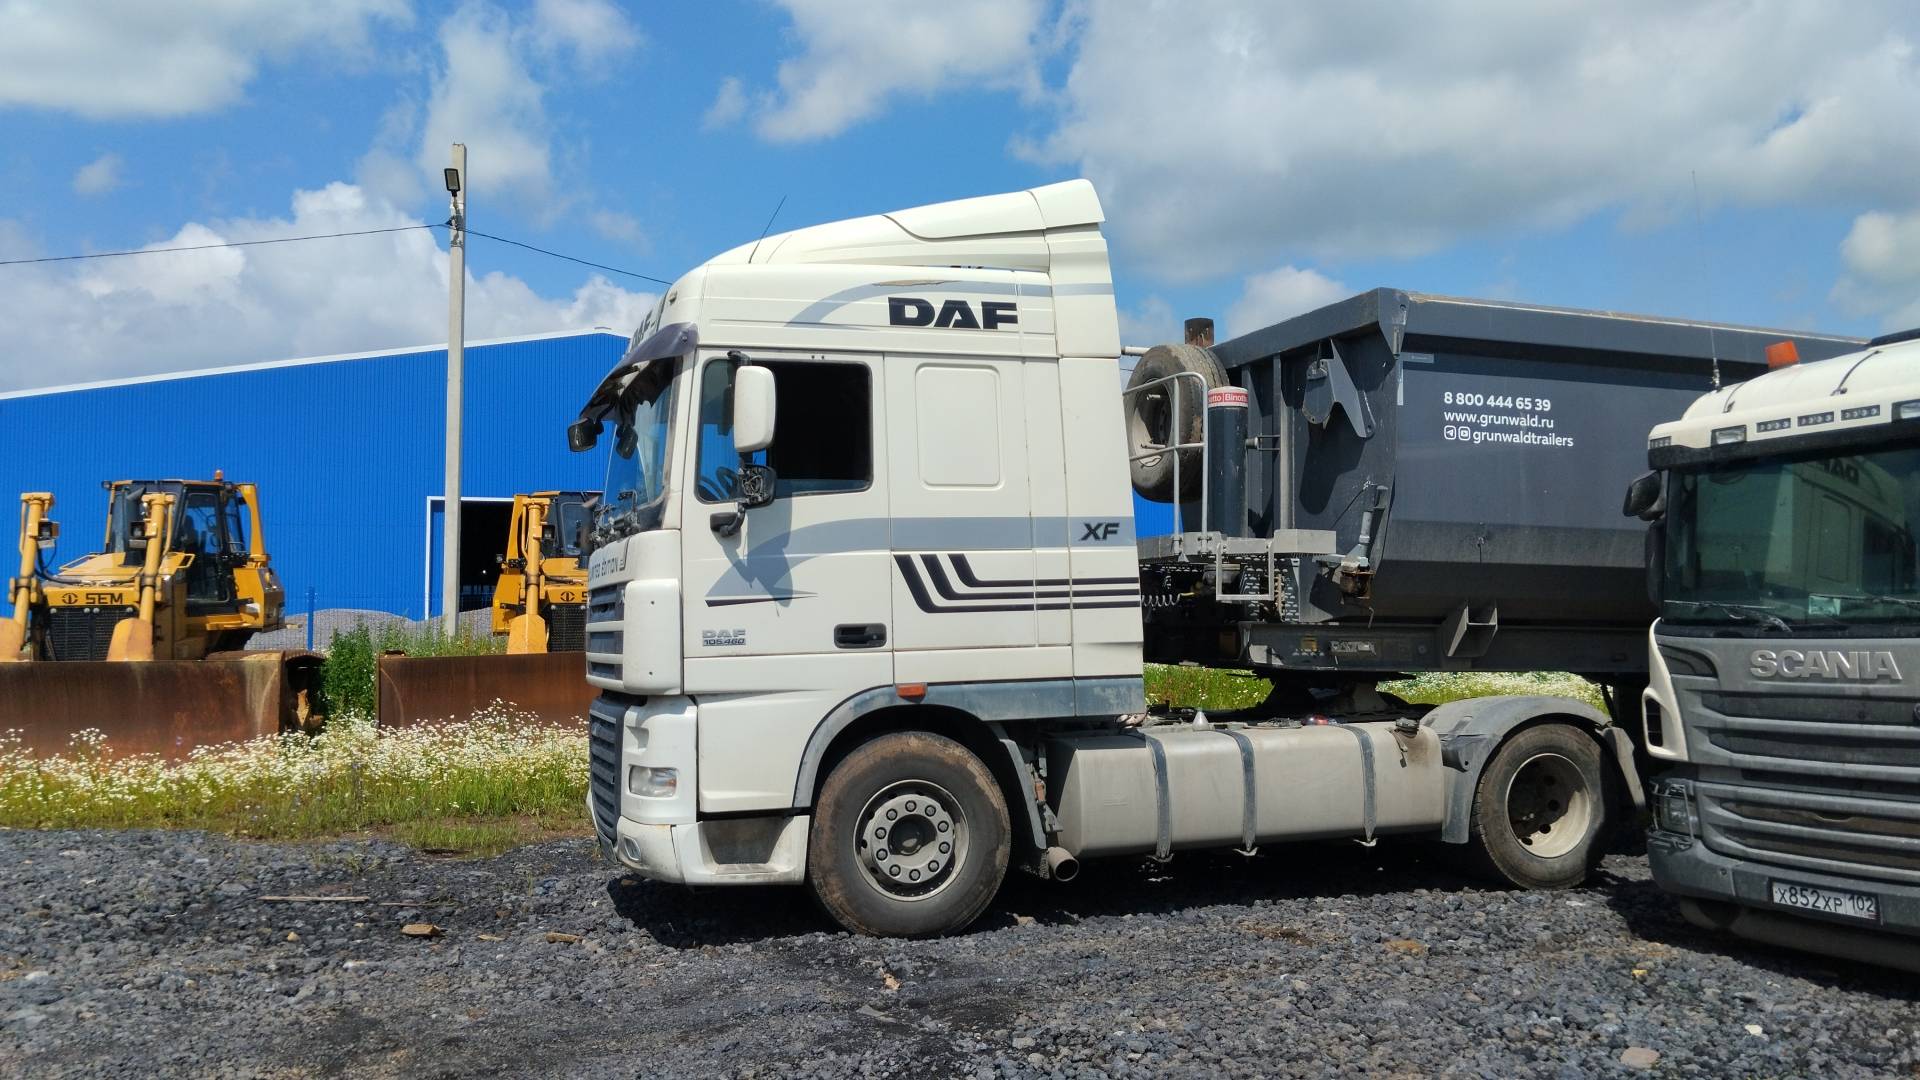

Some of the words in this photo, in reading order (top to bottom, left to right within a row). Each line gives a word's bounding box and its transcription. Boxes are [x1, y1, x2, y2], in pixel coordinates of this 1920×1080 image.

[888, 296, 1018, 330] DAF
[1444, 392, 1453, 404] 8
[1456, 393, 1484, 406] 800
[1486, 395, 1513, 408] 444
[1515, 397, 1532, 410] 65
[1534, 399, 1551, 411] 39
[1444, 411, 1554, 428] www.grunwald.ru
[1473, 430, 1574, 447] grunwaldtrailers
[1080, 522, 1120, 541] XF
[85, 592, 123, 605] SEM
[702, 629, 746, 639] DAF
[1750, 650, 1902, 680] SCANIA
[1778, 886, 1843, 912] Х852ХР
[1848, 895, 1875, 913] 102
